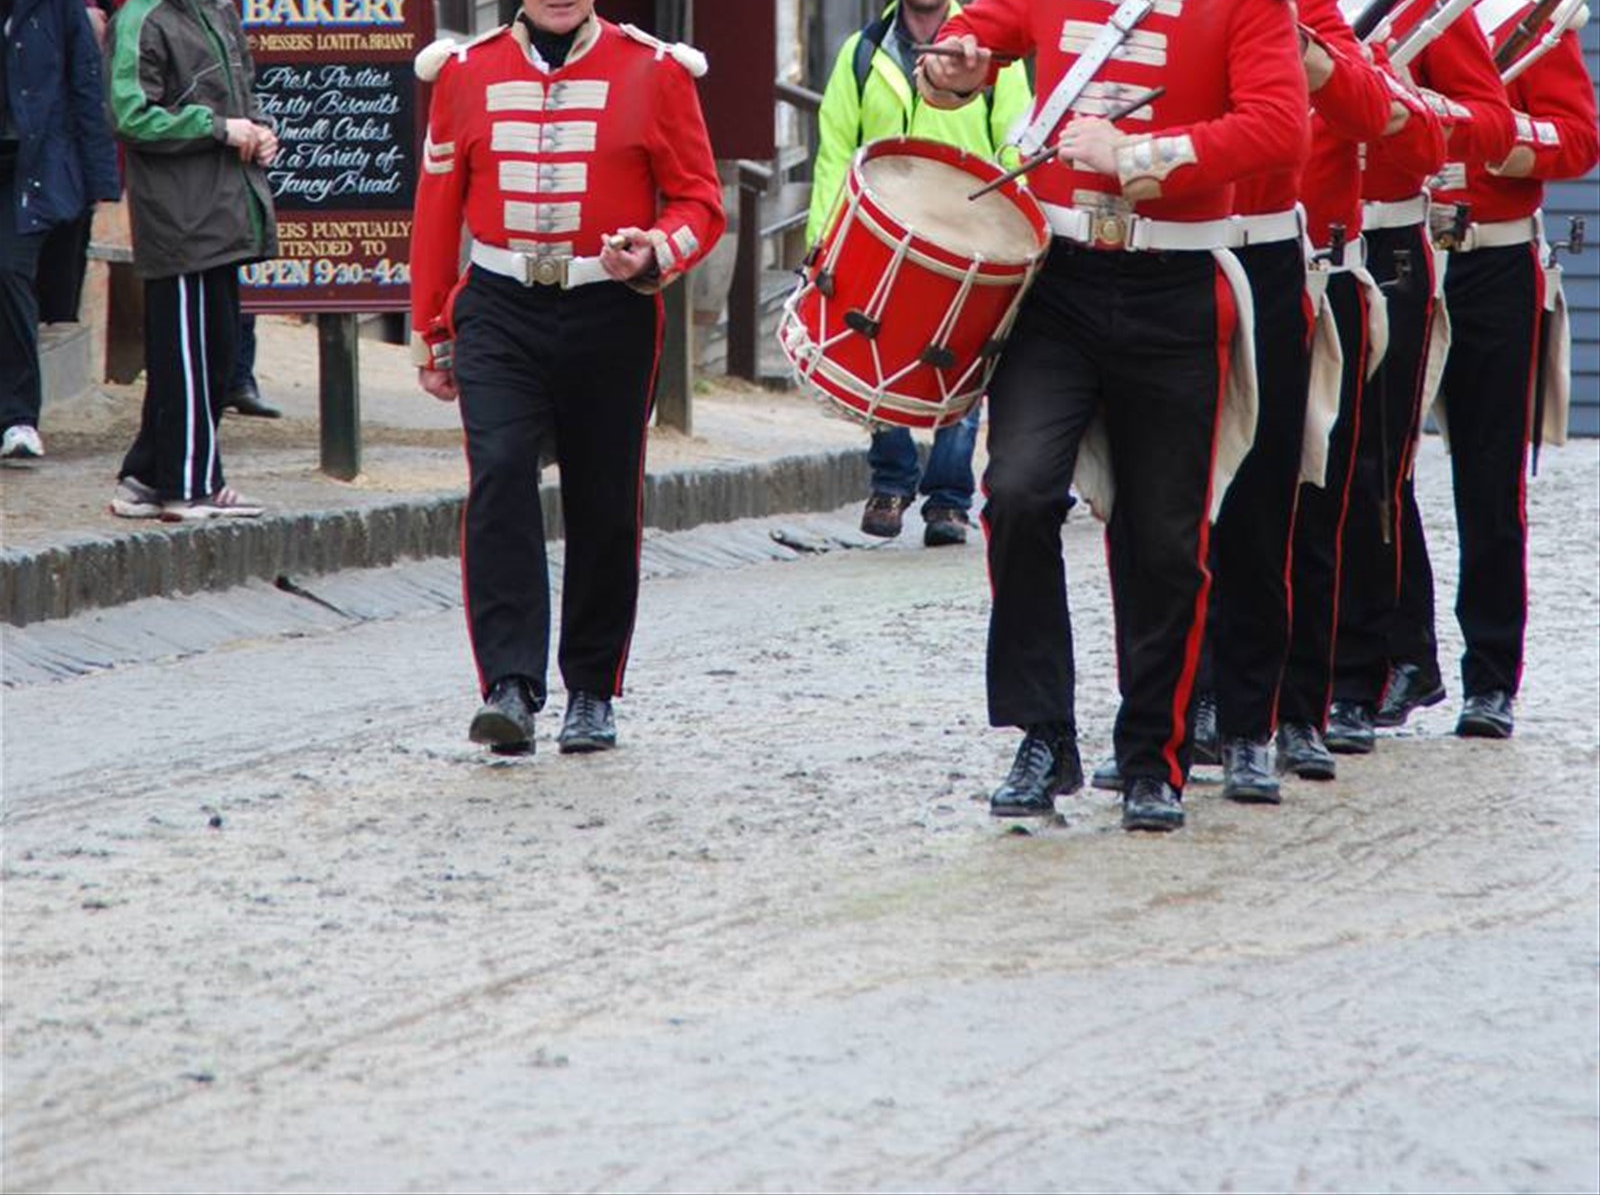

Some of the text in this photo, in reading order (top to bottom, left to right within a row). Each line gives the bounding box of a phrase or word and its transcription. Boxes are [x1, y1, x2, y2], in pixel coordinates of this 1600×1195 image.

[260, 34, 313, 51] MESSERS
[368, 33, 414, 50] BRIANT
[312, 65, 392, 90] Pasties
[314, 90, 400, 114] Biscuits
[332, 117, 392, 141] Cakes
[286, 153, 304, 167] a
[297, 142, 371, 171] Variety
[375, 145, 405, 173] of
[267, 170, 401, 202] Fancy Bread
[277, 221, 412, 238] ERS PUNCTUALLY
[278, 240, 387, 256] TTENDED TO
[238, 259, 312, 287] OPEN
